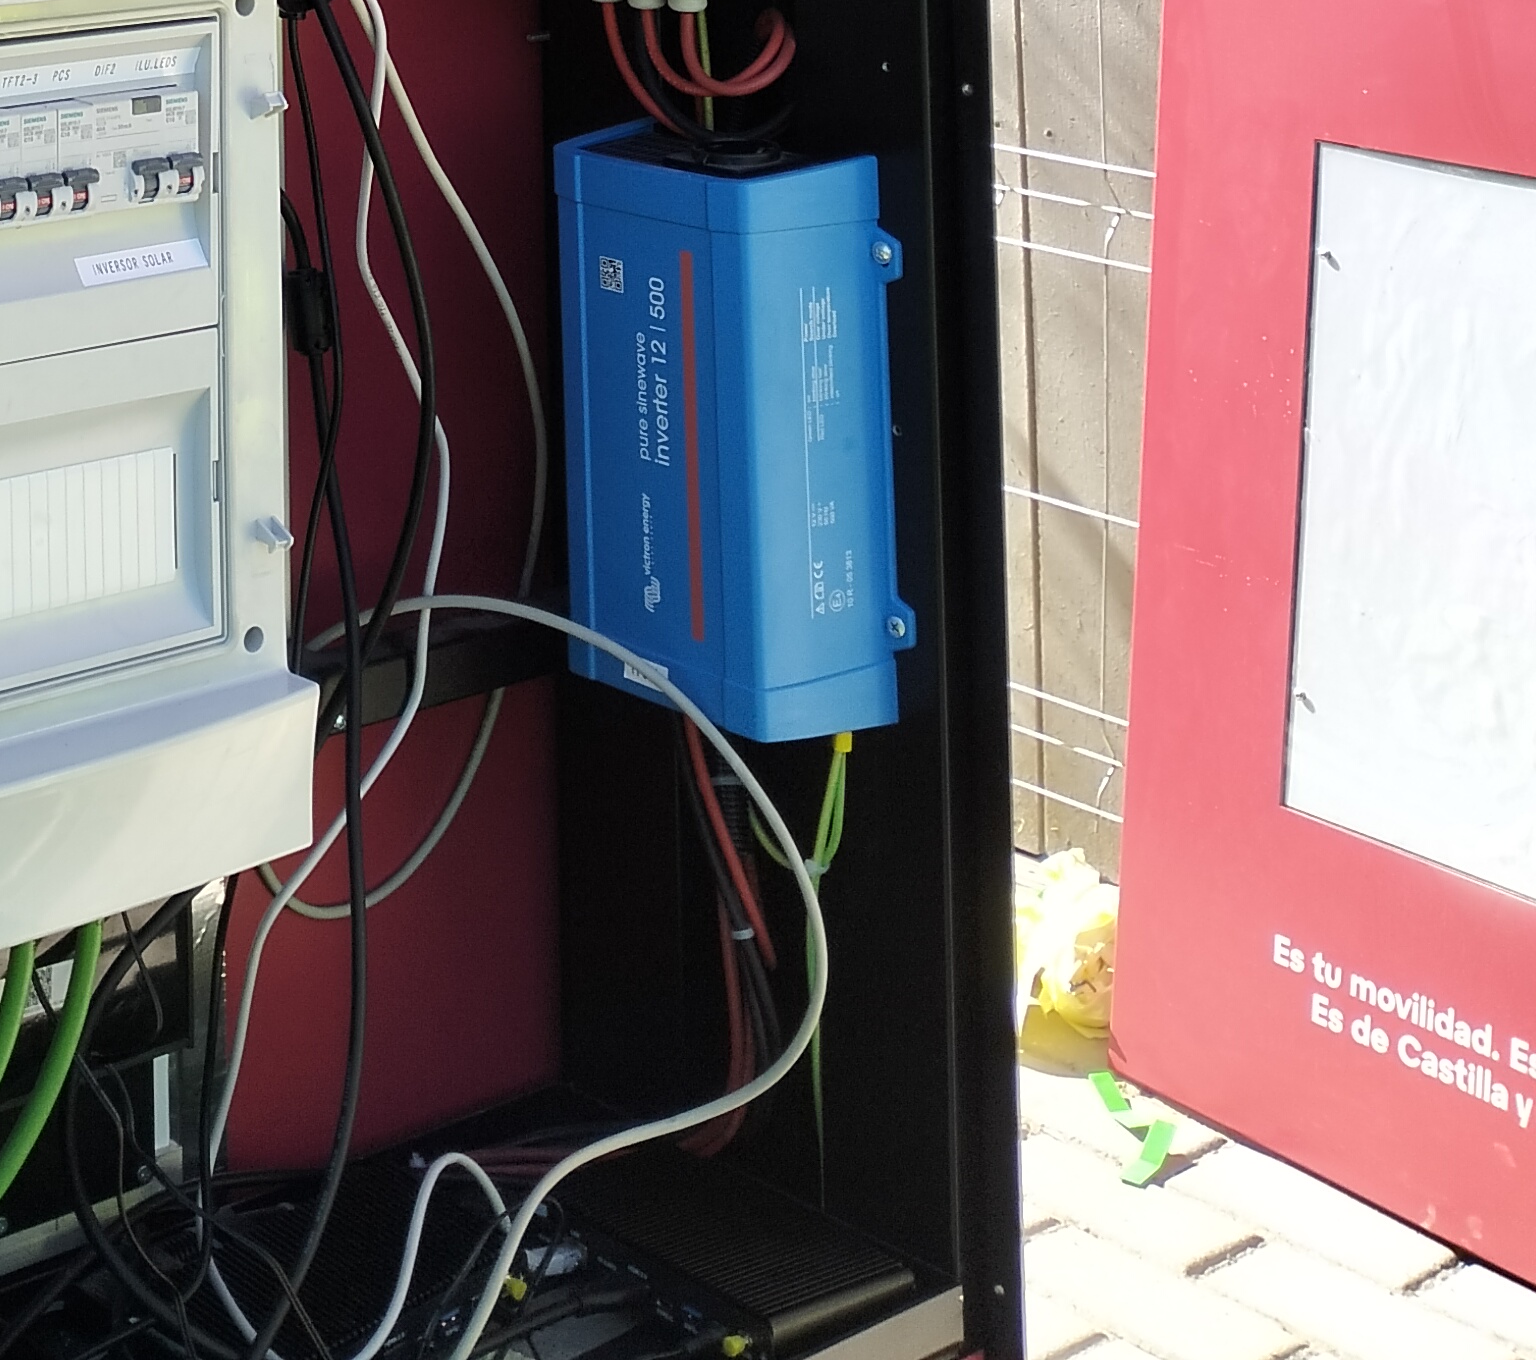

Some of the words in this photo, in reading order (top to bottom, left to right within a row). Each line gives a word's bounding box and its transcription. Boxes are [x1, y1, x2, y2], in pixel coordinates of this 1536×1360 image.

[2, 73, 38, 89] TFT2-3
[53, 69, 71, 82] PCS
[94, 63, 116, 77] DIF2
[135, 56, 177, 71] ILU.LEDS
[24, 116, 47, 125] SIEMENS
[96, 106, 119, 114] SIEMENS
[166, 97, 188, 105] SIEMENS
[92, 257, 139, 276] INVERSOR
[142, 251, 174, 268] SOLAR
[649, 277, 665, 320] 500
[651, 340, 667, 364] 12
[636, 332, 648, 415] sinewave
[638, 418, 652, 461] pure
[652, 374, 671, 467] inverter
[641, 493, 651, 534] energy
[1273, 933, 1305, 973] Es
[1312, 952, 1342, 989] tu
[1349, 973, 1500, 1061] movilidad.
[1311, 993, 1344, 1033] Es
[1351, 1014, 1389, 1053] de
[1397, 1034, 1509, 1111] Castilla
[1515, 1093, 1533, 1129] y
